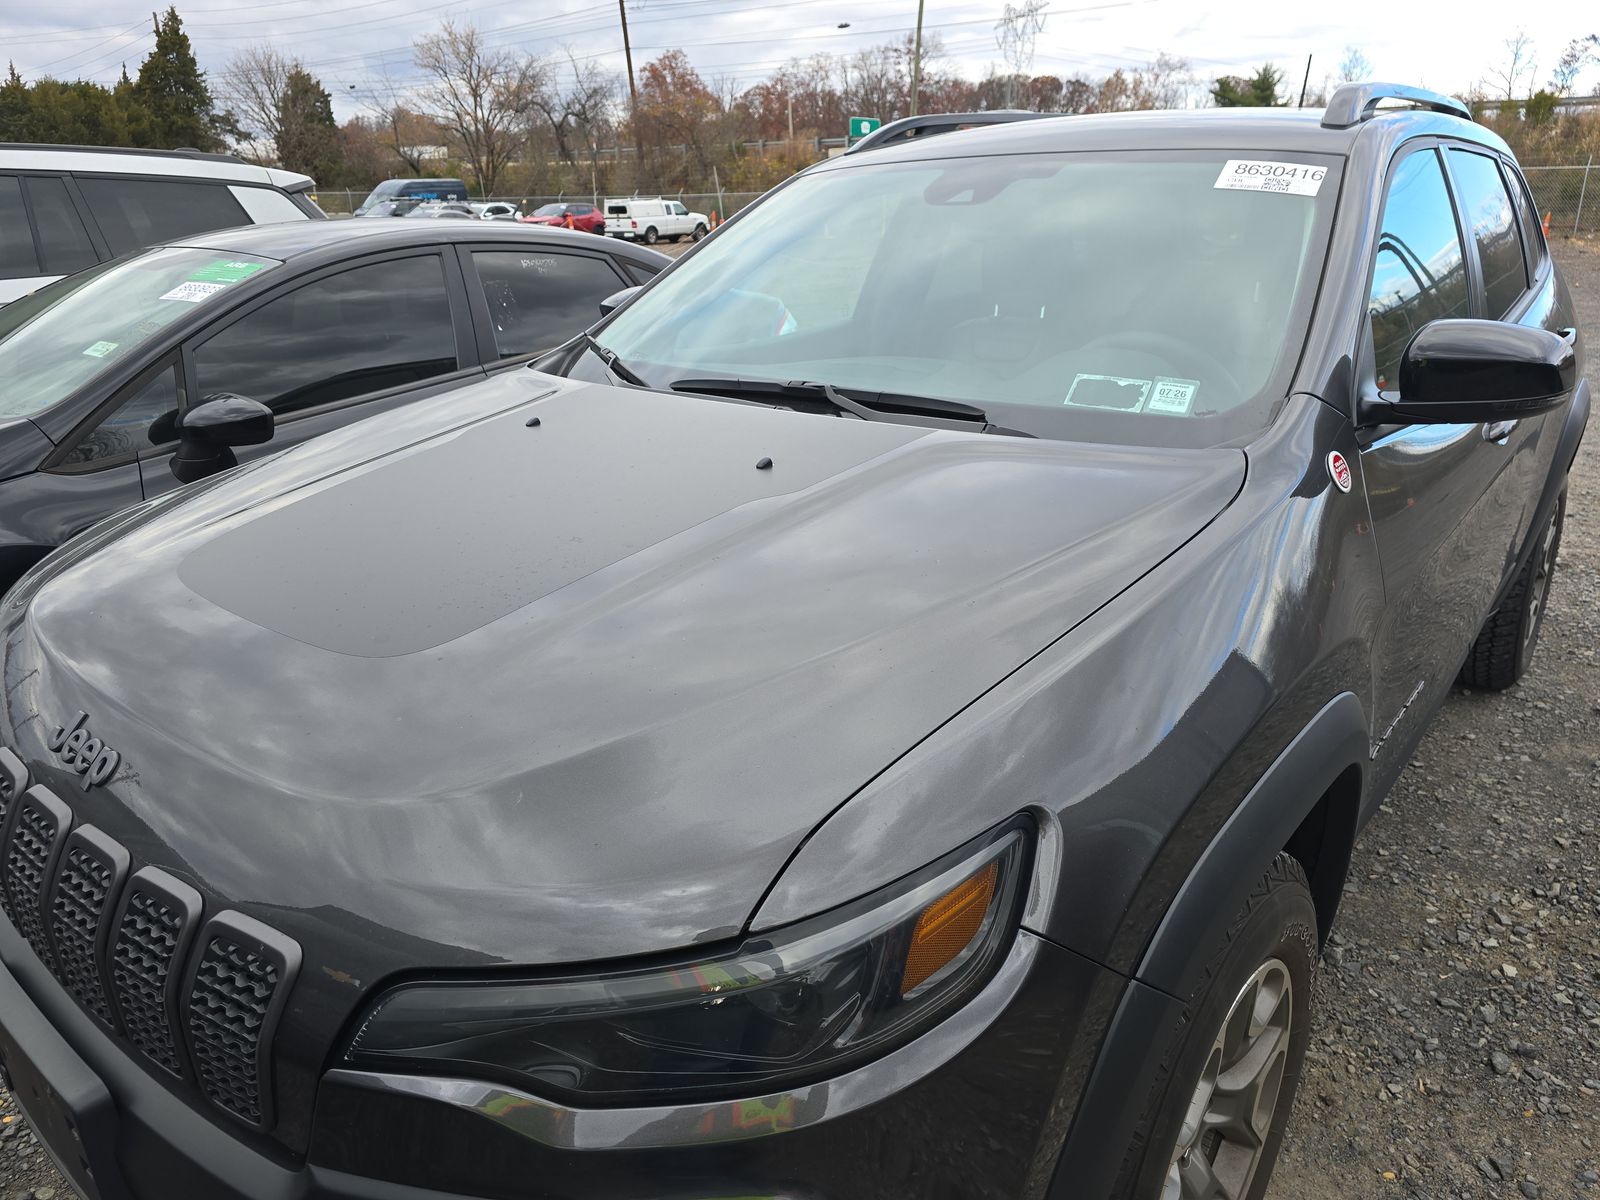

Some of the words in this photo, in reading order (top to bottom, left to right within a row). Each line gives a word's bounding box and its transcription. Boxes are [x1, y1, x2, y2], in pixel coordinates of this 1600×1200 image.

[1234, 163, 1325, 182] 8630416
[1158, 388, 1172, 397] 07
[1173, 389, 1187, 398] 26
[47, 710, 121, 792] Jeep
